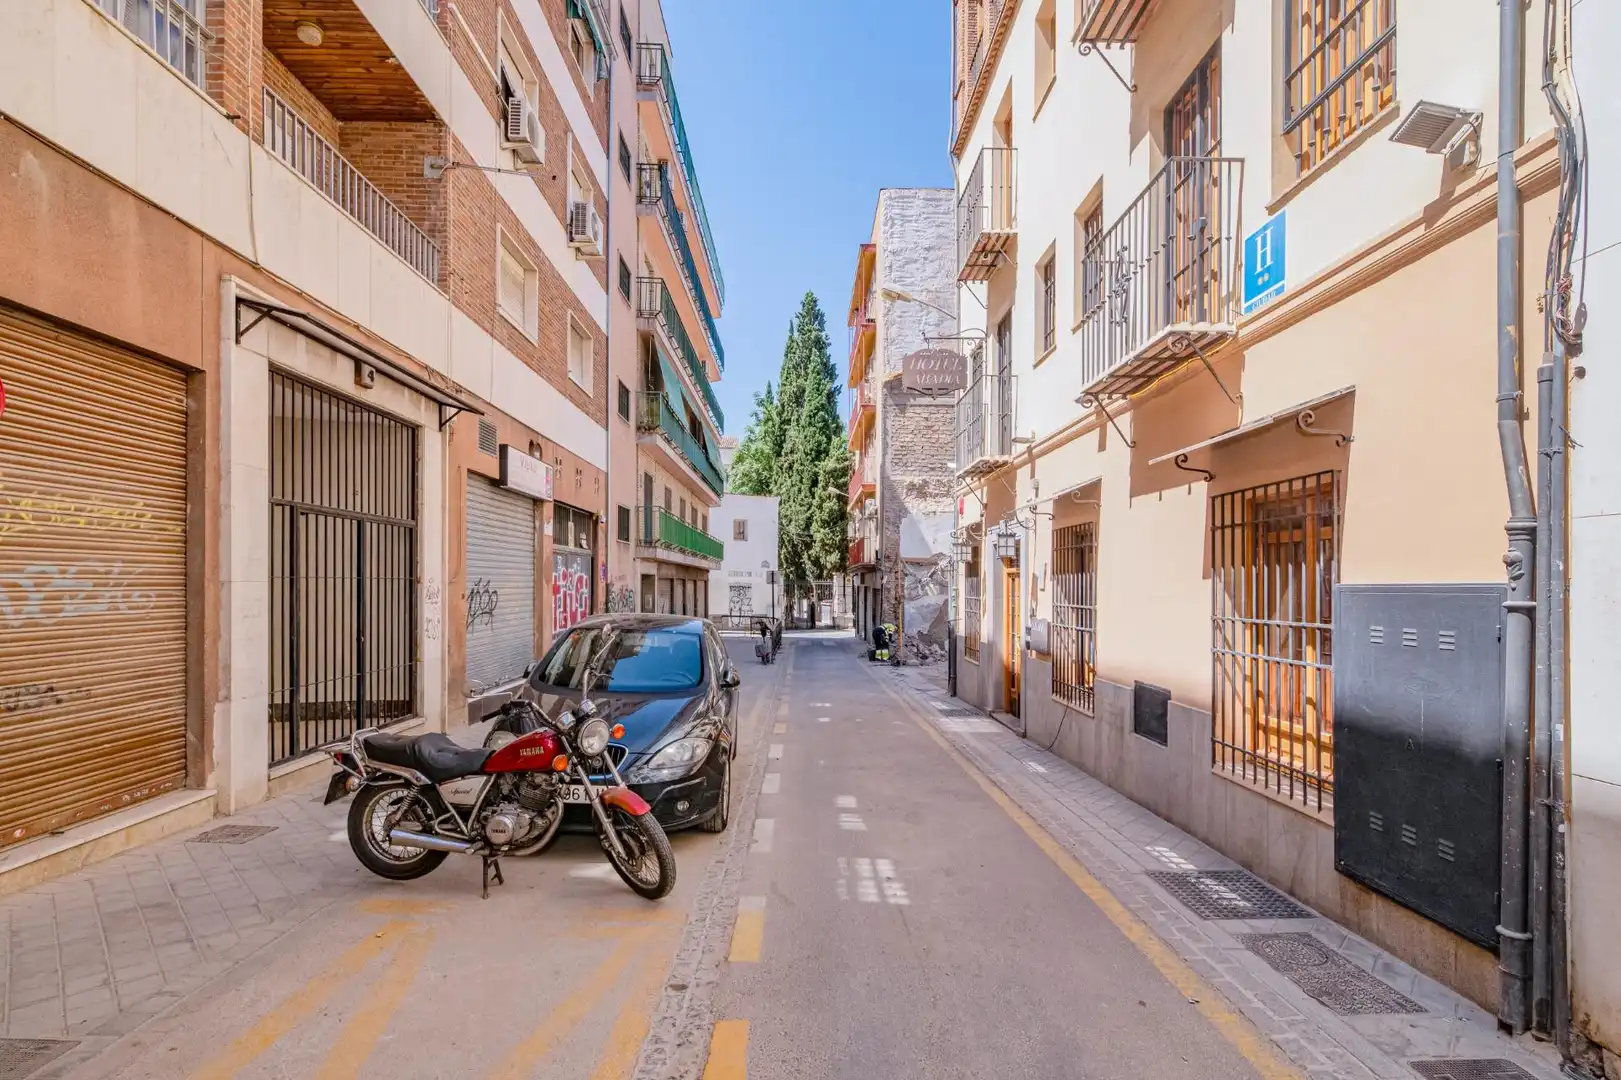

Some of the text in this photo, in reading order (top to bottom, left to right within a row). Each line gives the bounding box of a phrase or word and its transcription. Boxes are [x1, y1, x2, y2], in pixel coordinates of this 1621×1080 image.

[1253, 225, 1274, 275] H
[909, 357, 963, 371] HOTEL
[367, 369, 375, 384] 4
[519, 746, 545, 757] YAMAHA
